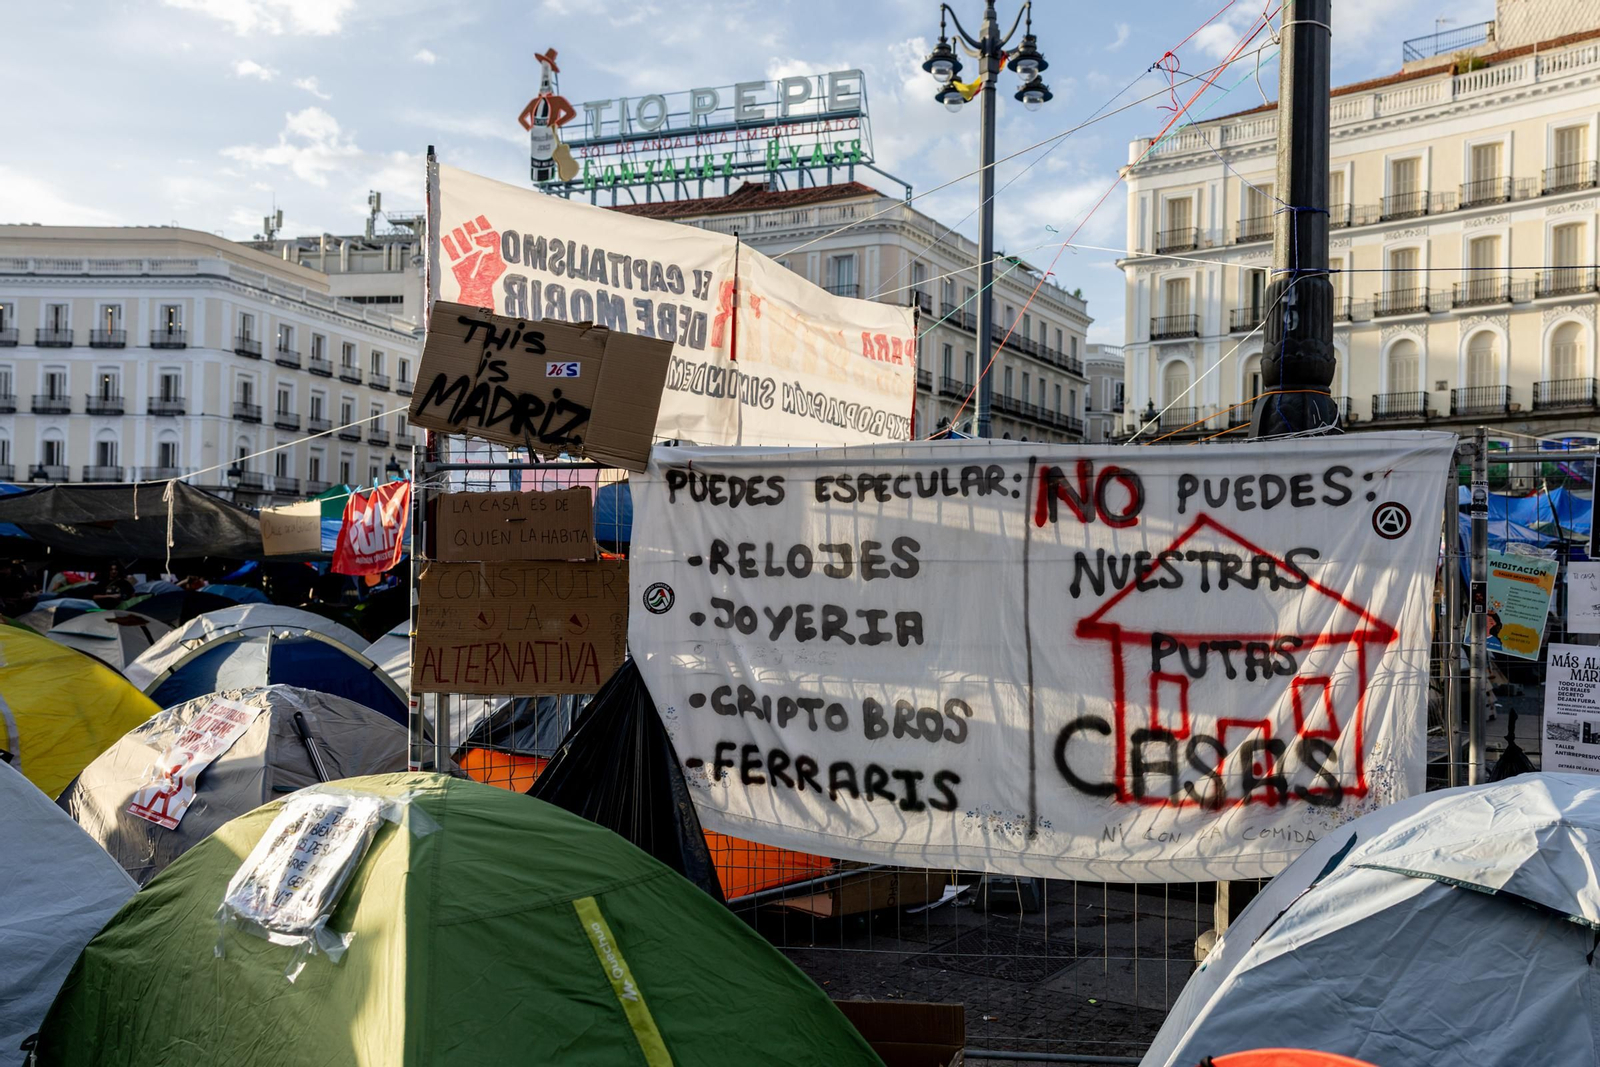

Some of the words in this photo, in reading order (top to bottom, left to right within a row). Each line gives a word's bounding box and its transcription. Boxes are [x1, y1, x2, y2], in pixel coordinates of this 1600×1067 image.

[583, 94, 667, 138] TIO
[690, 69, 862, 126] PEPE
[580, 146, 605, 158] SOL
[616, 143, 632, 155] DE
[736, 117, 859, 141] EMBOTELLADO
[452, 501, 472, 514] LA
[479, 496, 520, 513] CASA
[530, 498, 547, 511] ES
[555, 498, 569, 512] DE
[665, 467, 786, 508] PUEDES
[814, 464, 1023, 503] ESPECULAR:
[1035, 458, 1146, 528] NO
[1177, 464, 1378, 515] PUEDES:
[454, 528, 511, 546] QUIEN
[520, 528, 538, 544] LA
[541, 528, 590, 544] HABITA
[437, 567, 618, 602] CONSTRUIR
[1069, 547, 1320, 599] NUESTRAS
[1489, 560, 1547, 578] MEDITACIÓN
[507, 603, 542, 631] LA
[1151, 632, 1303, 682] PUTAS
[1552, 652, 1580, 669] MÁS
[1584, 657, 1600, 670] AL
[862, 697, 973, 745] BROS
[1053, 714, 1343, 808] CASAS
[591, 922, 624, 980] Quechua
